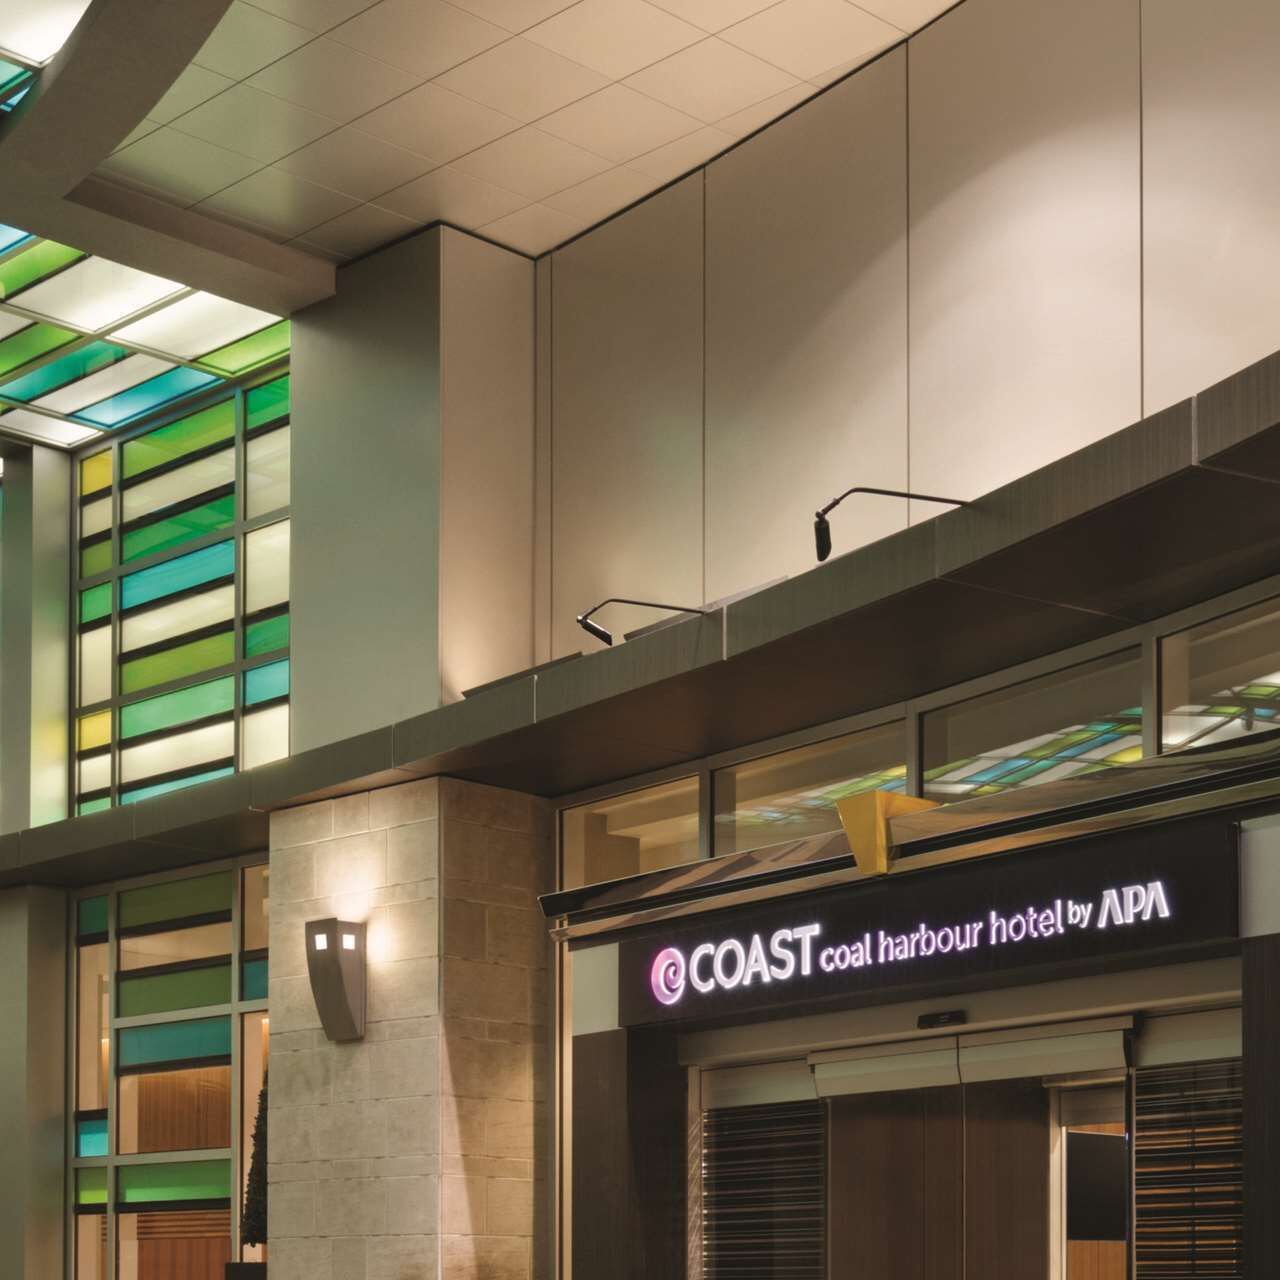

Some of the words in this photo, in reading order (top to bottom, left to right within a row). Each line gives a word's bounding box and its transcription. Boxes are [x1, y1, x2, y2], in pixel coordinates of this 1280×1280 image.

[689, 923, 821, 993] COAST
[820, 932, 872, 972] coal
[877, 921, 984, 963] harbour
[988, 899, 1065, 946] hotel
[1067, 900, 1093, 929] by
[1097, 880, 1170, 929] APA
